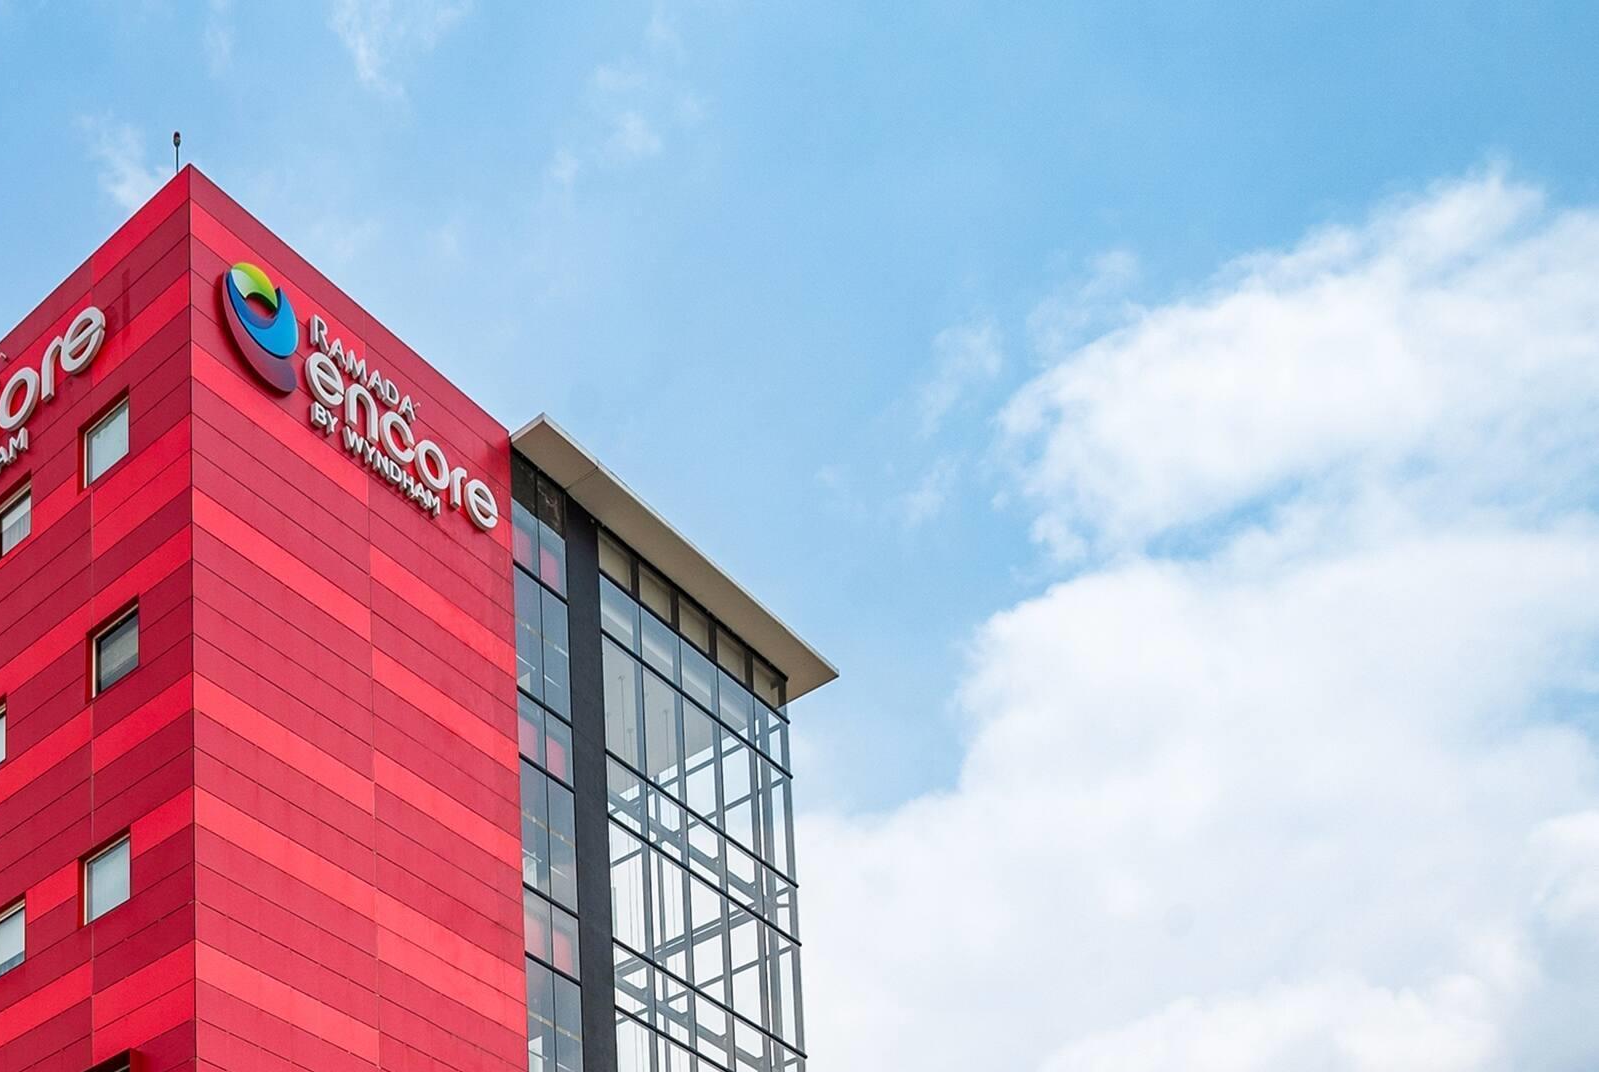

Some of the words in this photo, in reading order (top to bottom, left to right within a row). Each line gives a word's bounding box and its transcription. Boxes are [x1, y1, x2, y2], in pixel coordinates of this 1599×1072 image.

[310, 314, 417, 421] RAMADA
[305, 351, 499, 531] encore
[311, 401, 339, 435] BY
[342, 426, 442, 518] WYNDHAM
